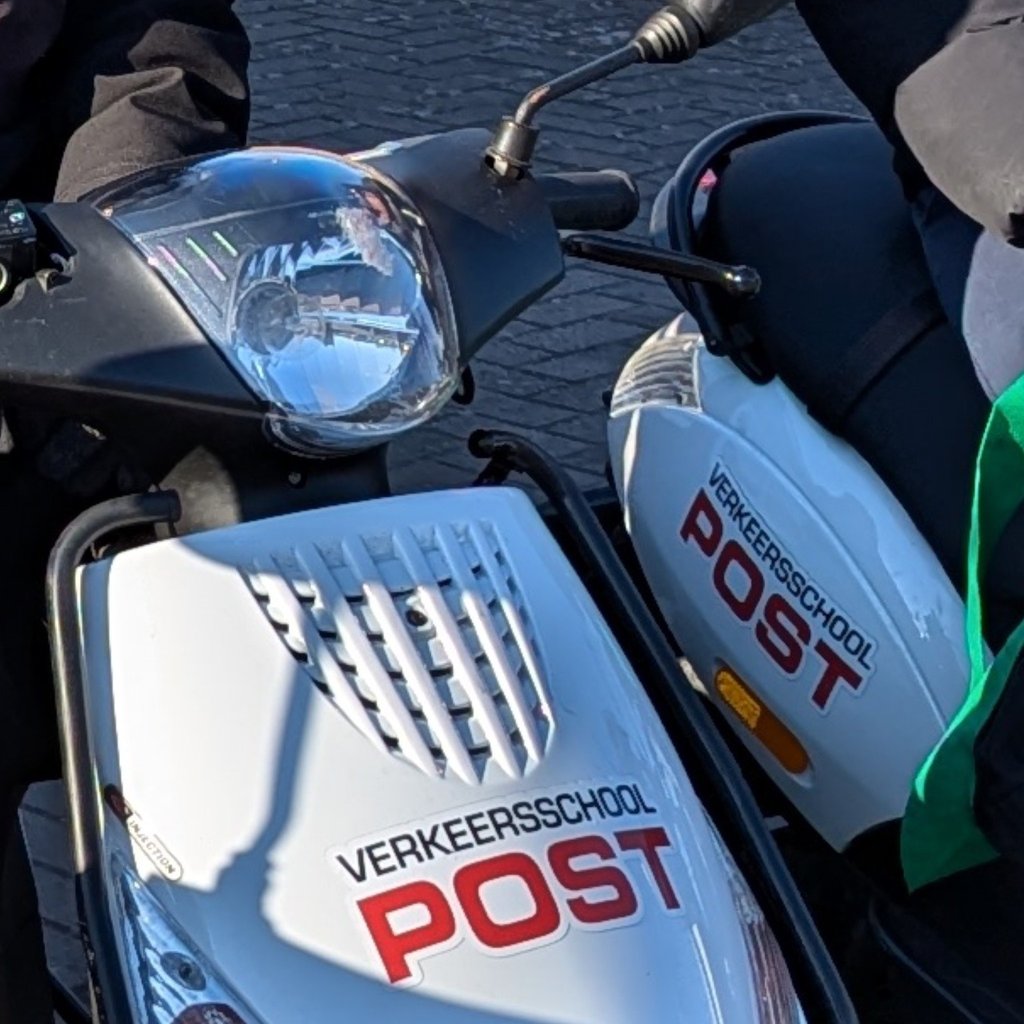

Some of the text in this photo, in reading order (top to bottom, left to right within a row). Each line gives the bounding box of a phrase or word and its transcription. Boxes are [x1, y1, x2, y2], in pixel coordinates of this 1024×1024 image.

[680, 487, 862, 709] POST
[709, 462, 873, 670] VERKEERSSCHOOL
[336, 783, 656, 883] VERKEERSSCHOOL
[356, 827, 680, 984] POST
